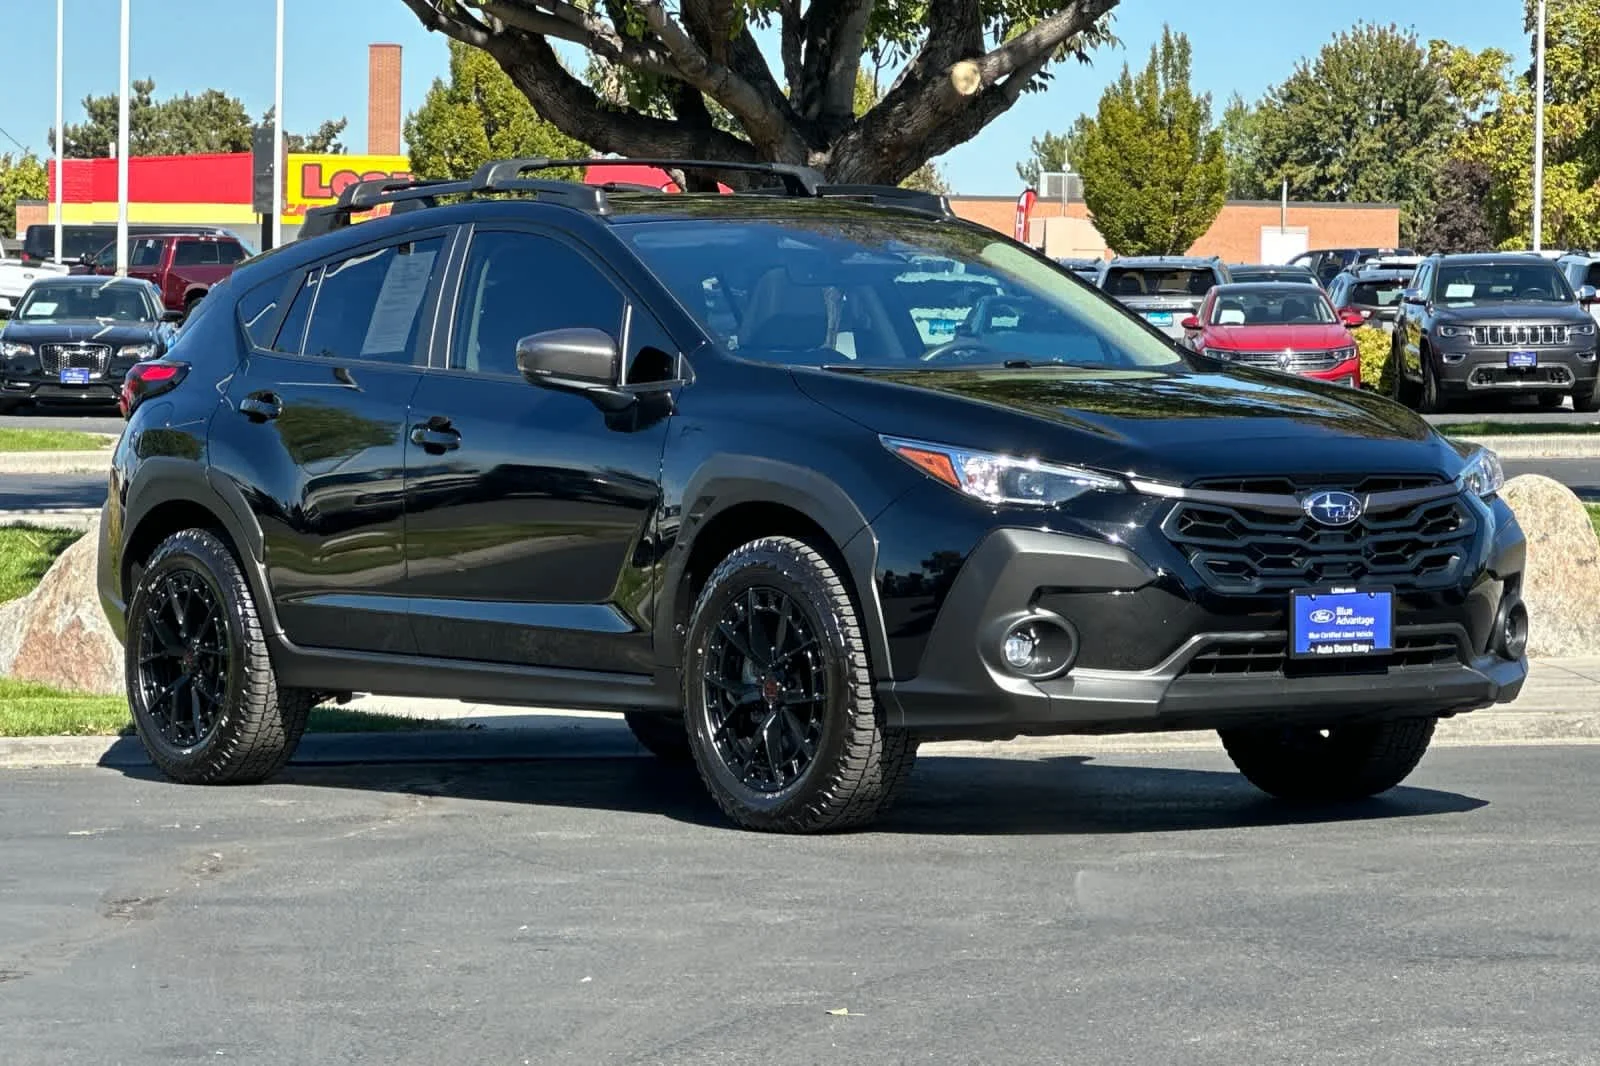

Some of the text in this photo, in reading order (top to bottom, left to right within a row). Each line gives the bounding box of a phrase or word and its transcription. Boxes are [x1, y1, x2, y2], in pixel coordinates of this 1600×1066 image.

[1336, 607, 1353, 616] Blue
[1336, 616, 1375, 626] Advantage
[1321, 631, 1342, 639] Certified
[1317, 645, 1333, 654] Auto
[1352, 643, 1369, 653] Easy
